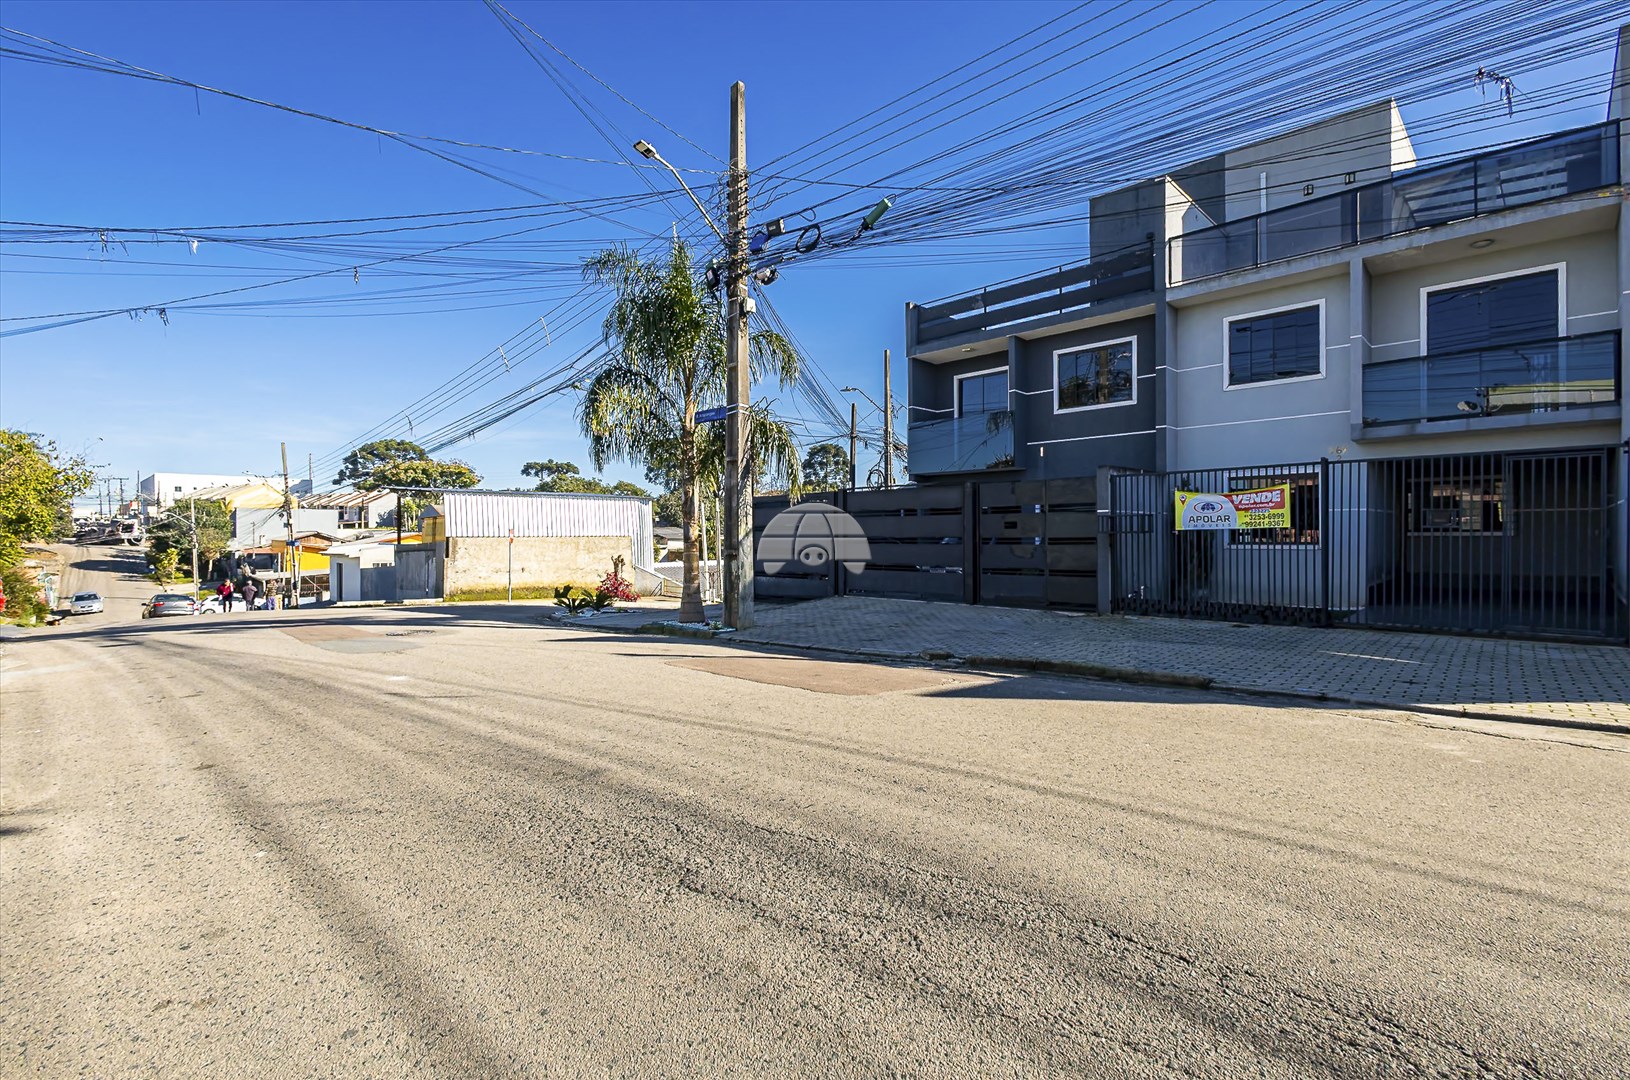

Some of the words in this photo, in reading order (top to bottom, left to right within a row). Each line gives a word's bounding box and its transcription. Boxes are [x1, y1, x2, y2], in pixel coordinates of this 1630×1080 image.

[1232, 490, 1281, 504] VENDE
[1188, 514, 1232, 523] APOLAR
[1249, 512, 1285, 520] 3253-6999
